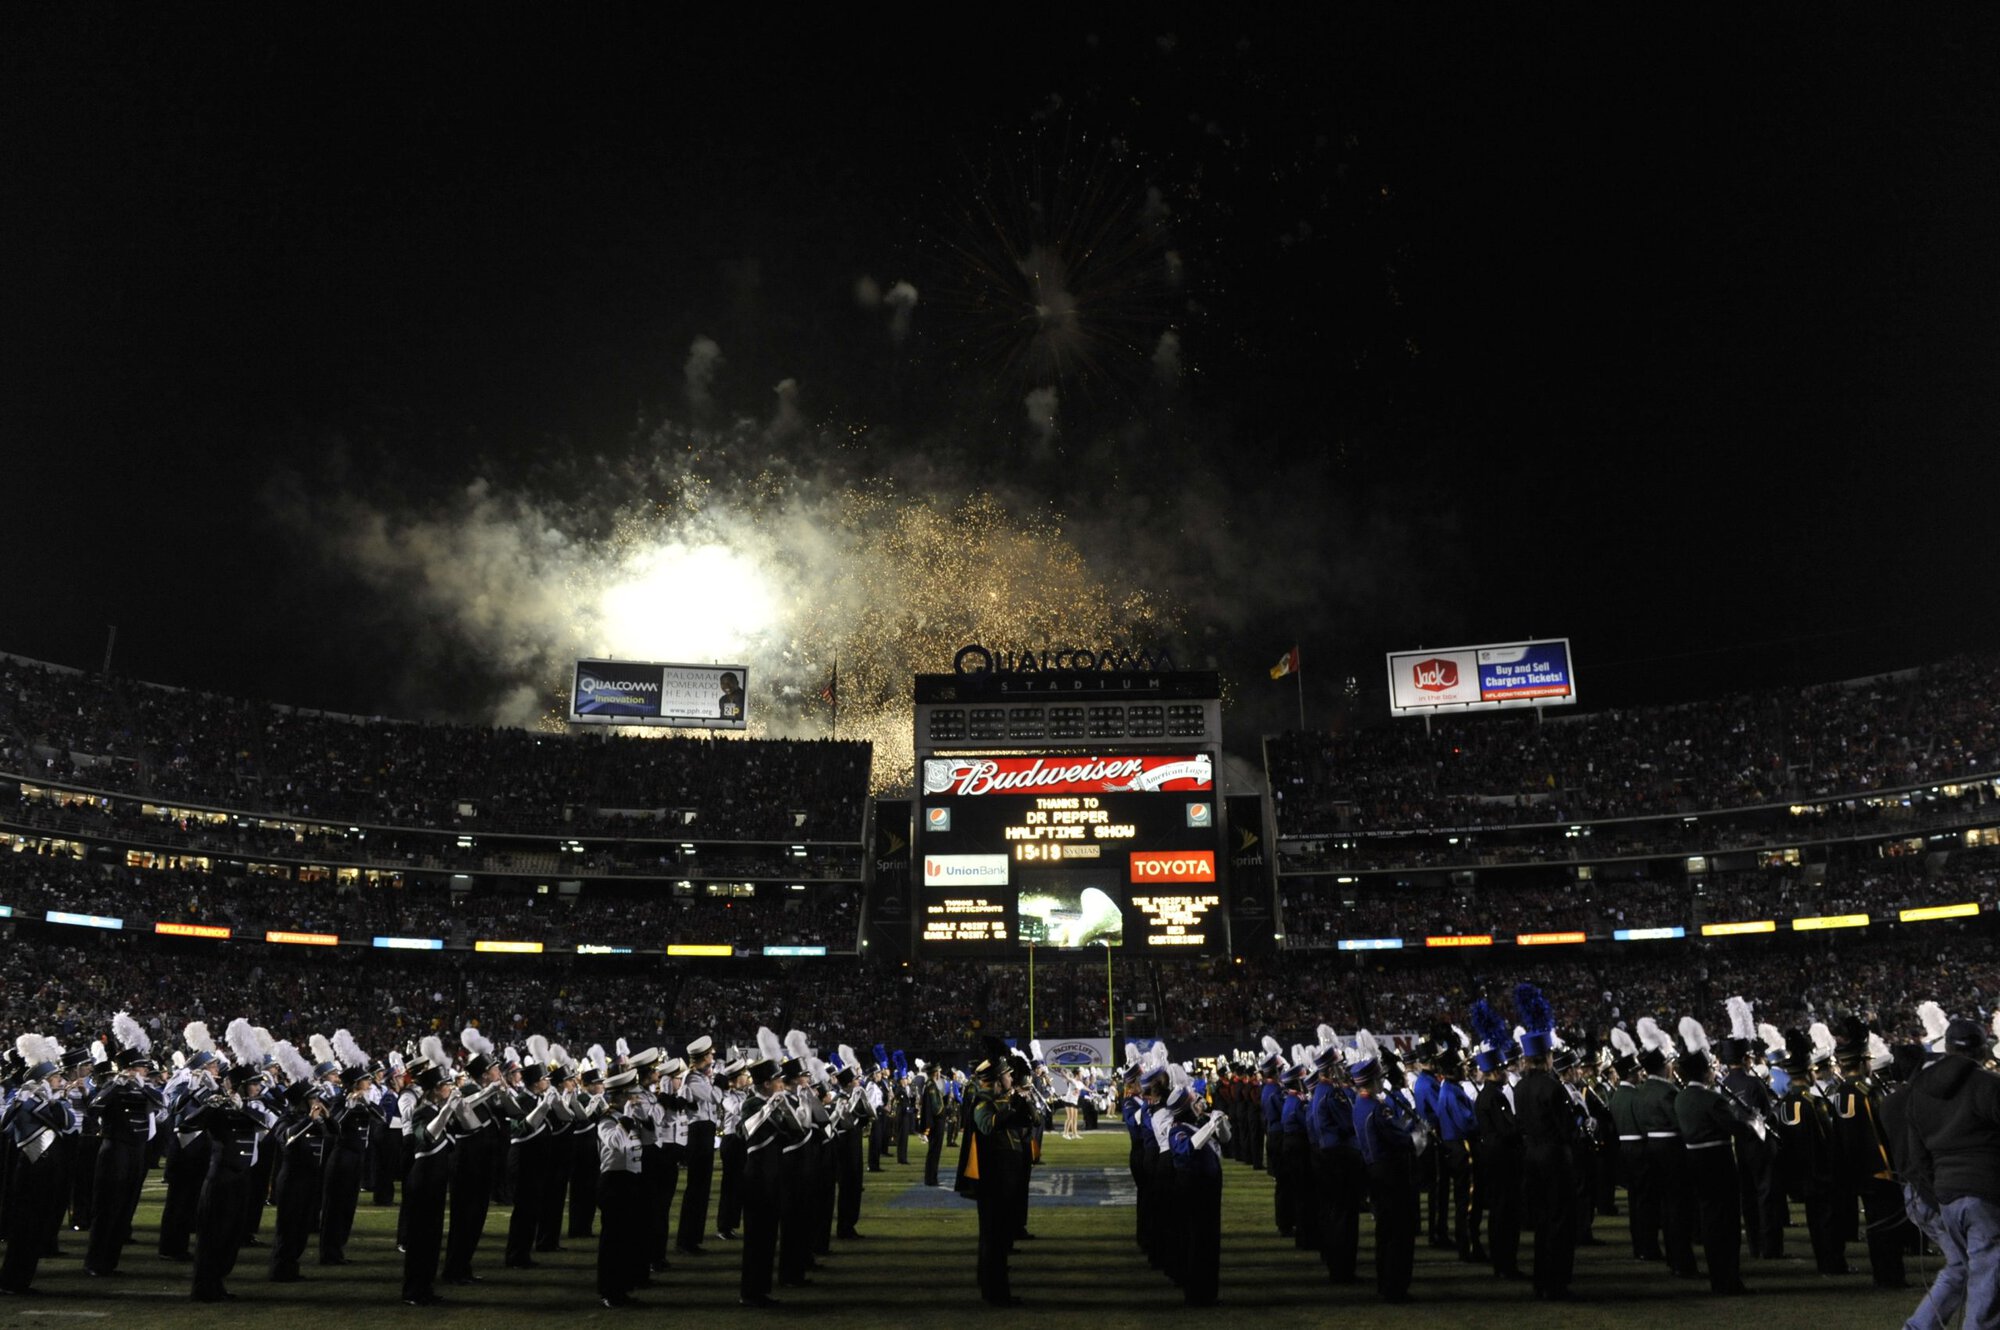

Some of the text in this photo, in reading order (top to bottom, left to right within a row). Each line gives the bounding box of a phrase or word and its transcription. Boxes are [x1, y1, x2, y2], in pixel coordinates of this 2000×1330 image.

[954, 644, 1176, 688] QUALCOMM
[1496, 662, 1549, 676] Buy and Sell
[667, 671, 719, 681] PALOMAR
[1415, 662, 1457, 688] Jack
[1485, 672, 1563, 688] Chargers Tickets!
[581, 678, 658, 694] QUALCOMM
[666, 681, 719, 690] POMERADO
[1001, 678, 1160, 691] STADIUM
[595, 695, 645, 704] Innovation
[666, 690, 718, 699] HEALTH
[952, 757, 1142, 796] Budweiser
[1145, 765, 1210, 786] American Lager
[1036, 797, 1099, 809] THANKS TO
[1026, 810, 1109, 824] DR PEPPER
[1005, 825, 1136, 840] HALFTIME SHOW
[876, 859, 907, 872] Sprint
[1134, 860, 1211, 875] TOYOTA
[1231, 854, 1263, 868] Sprint
[946, 864, 1006, 876] UnionBank
[157, 923, 229, 937] WELLS FARGO
[960, 922, 988, 930] POINT
[1460, 937, 1491, 945] FARGO
[1053, 1044, 1094, 1055] PACIFIC LIFE
